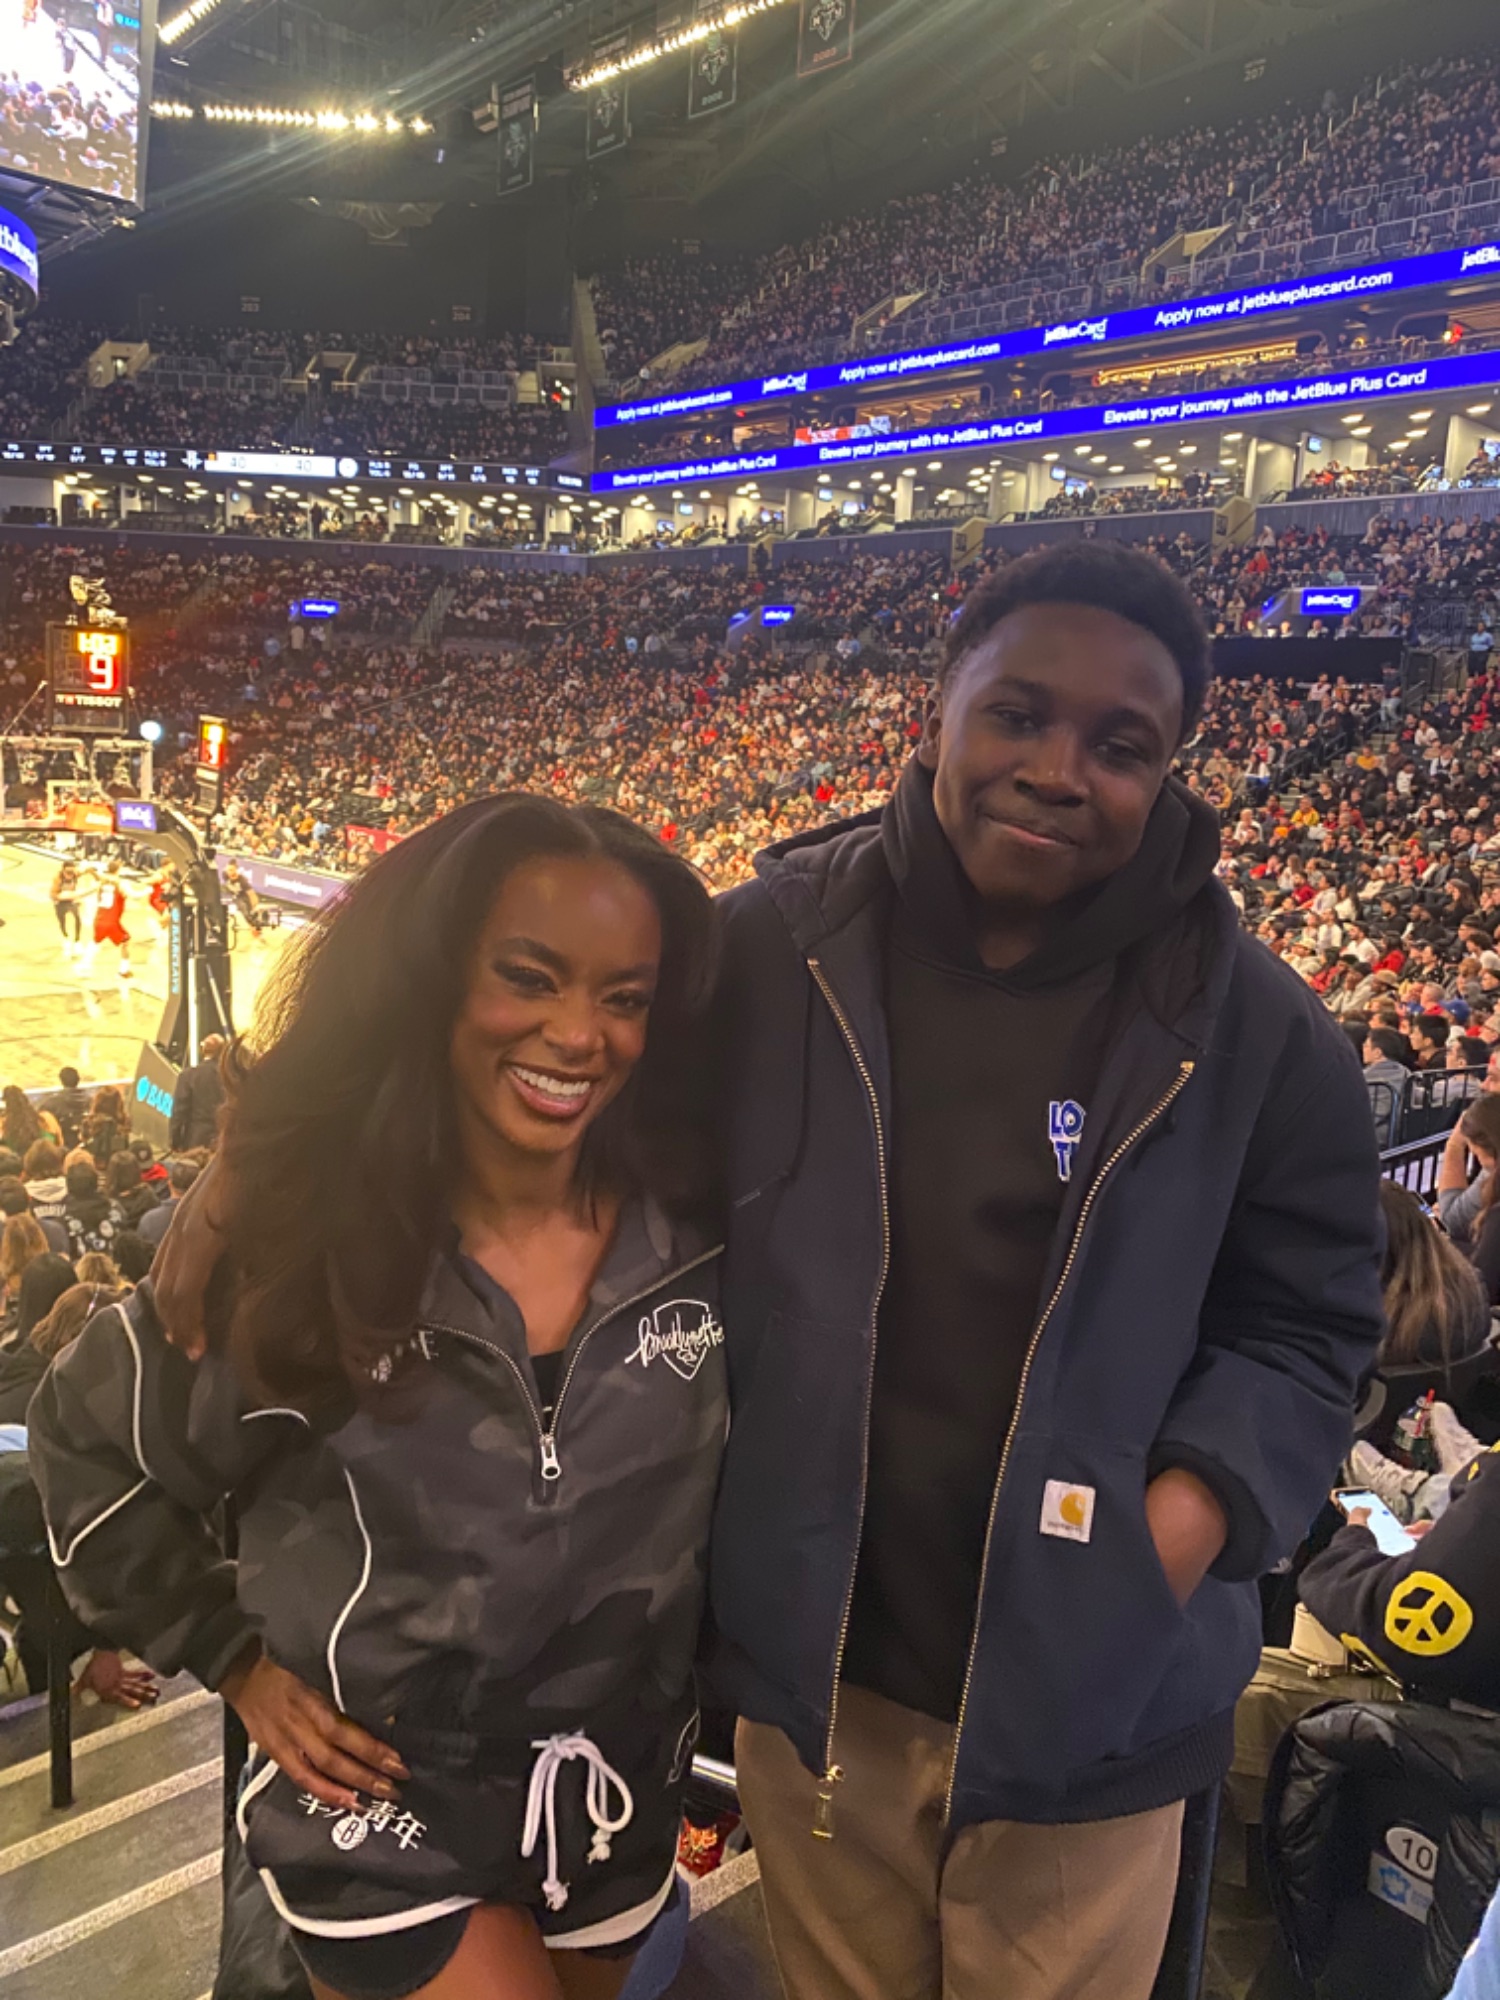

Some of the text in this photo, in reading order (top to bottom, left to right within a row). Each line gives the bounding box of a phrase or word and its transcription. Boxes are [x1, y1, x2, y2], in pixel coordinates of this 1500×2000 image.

[1154, 272, 1392, 327] Apply now at jetbluepluscard.com
[840, 366, 867, 381] Apply
[867, 364, 887, 374] now
[888, 360, 898, 371] at
[1104, 369, 1427, 424] Elevate your journey with the JetBlue Plus Card
[820, 420, 1042, 460] Elevate your journey with the JetBlue Plus Card
[1402, 1838, 1433, 1871] 10
